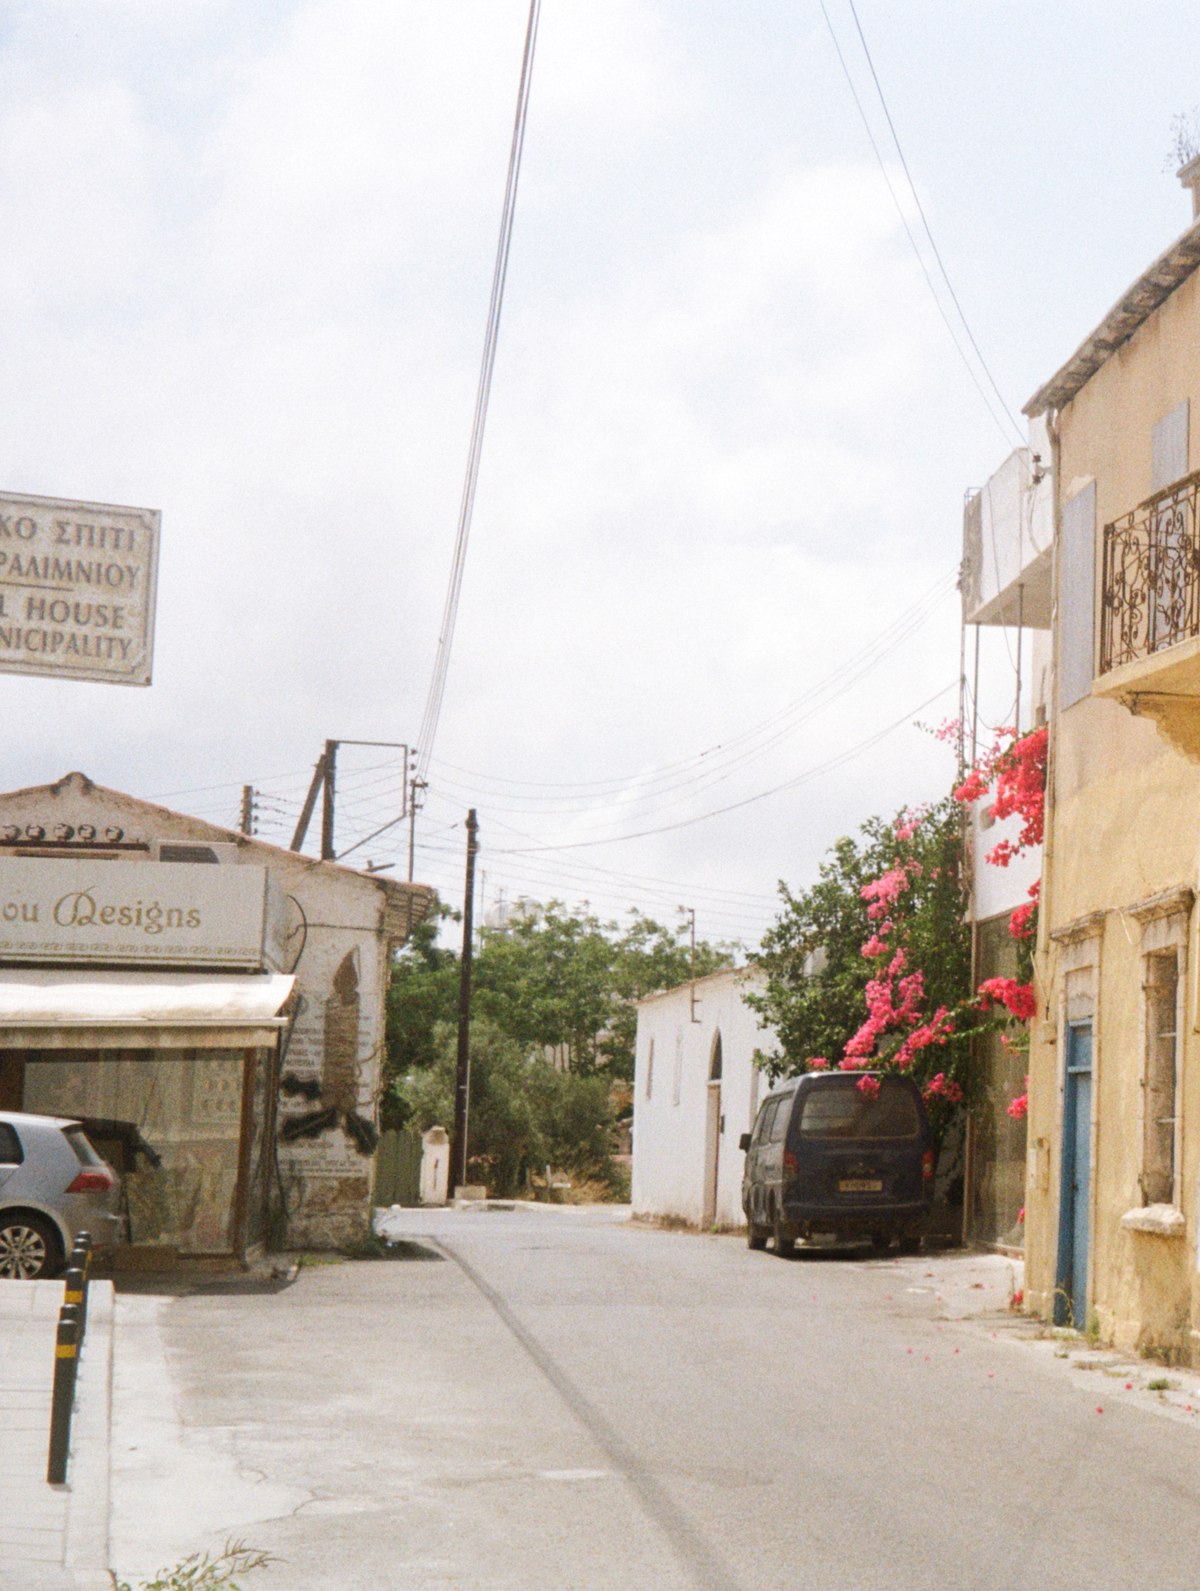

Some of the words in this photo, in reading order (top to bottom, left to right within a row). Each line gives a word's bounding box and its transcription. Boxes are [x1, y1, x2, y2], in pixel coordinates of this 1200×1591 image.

[55, 521, 136, 552] ΣΠΙΤΙ
[26, 597, 125, 629] HOUSE
[53, 885, 202, 934] Designs
